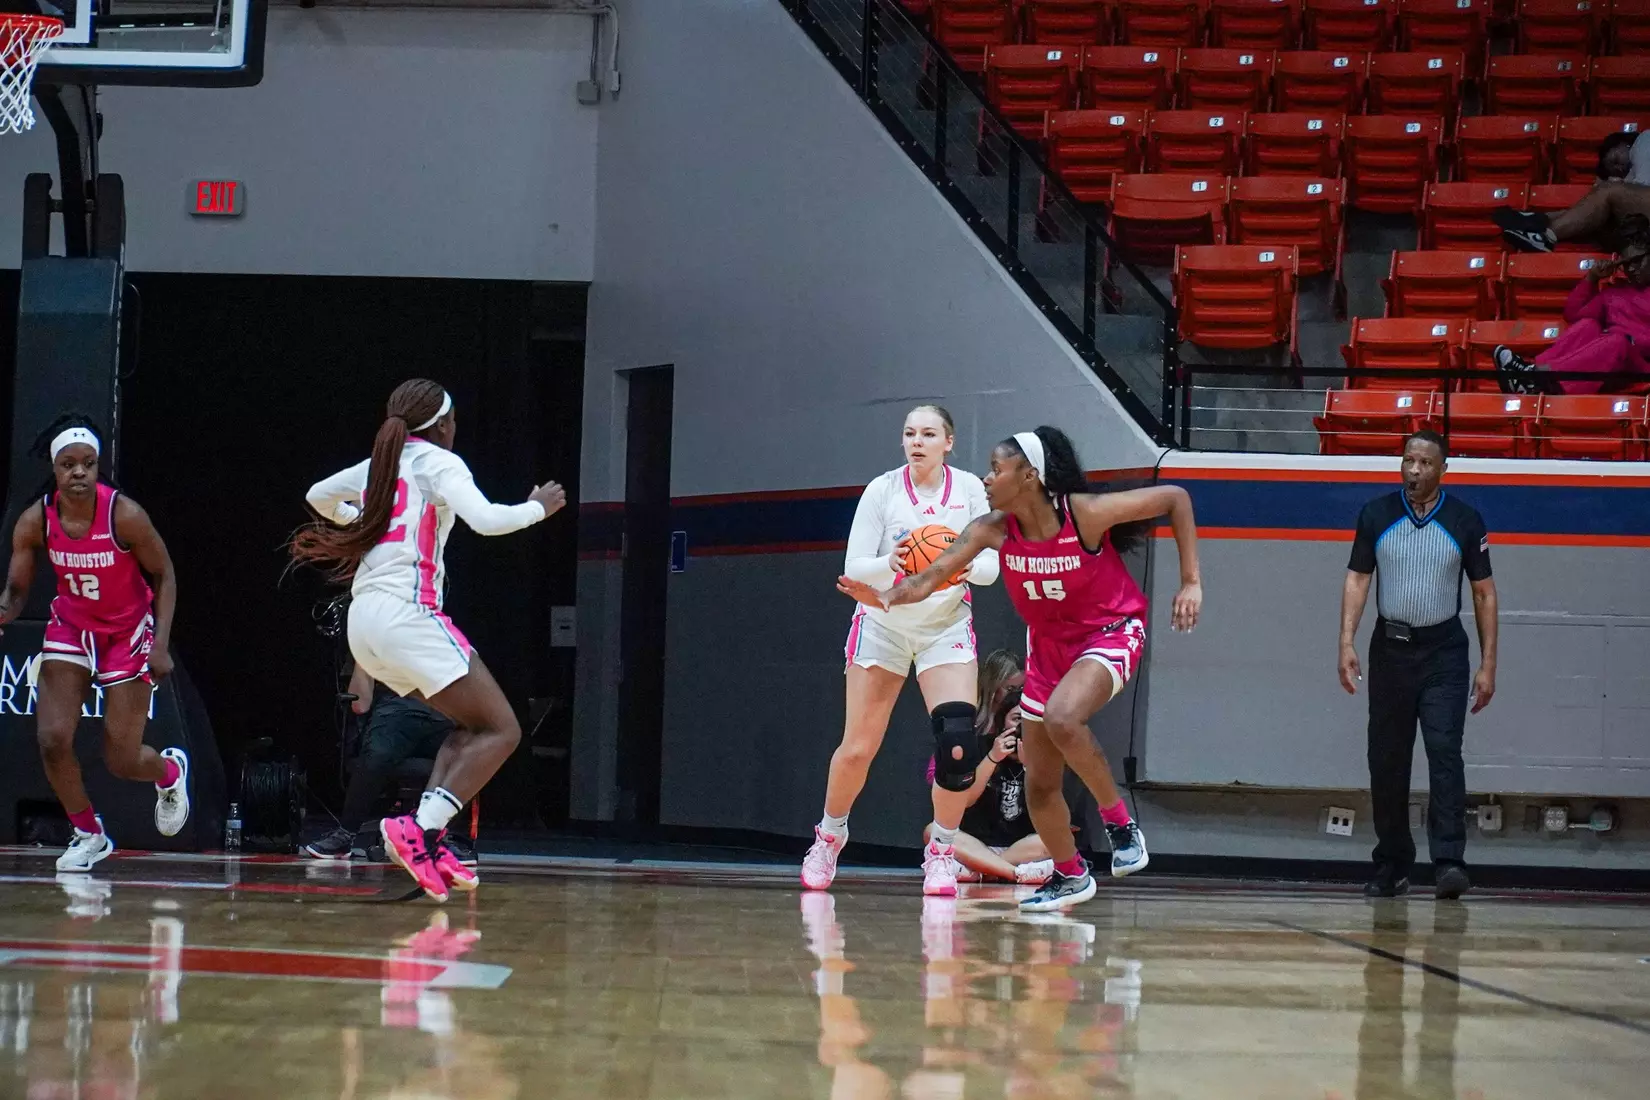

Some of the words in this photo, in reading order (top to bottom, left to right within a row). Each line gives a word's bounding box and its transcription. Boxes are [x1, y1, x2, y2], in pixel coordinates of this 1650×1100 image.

[196, 181, 237, 213] EXIT
[66, 551, 116, 569] HOUSTON
[1028, 556, 1081, 574] HOUSTON
[64, 573, 100, 601] 12
[1022, 580, 1067, 602] 15
